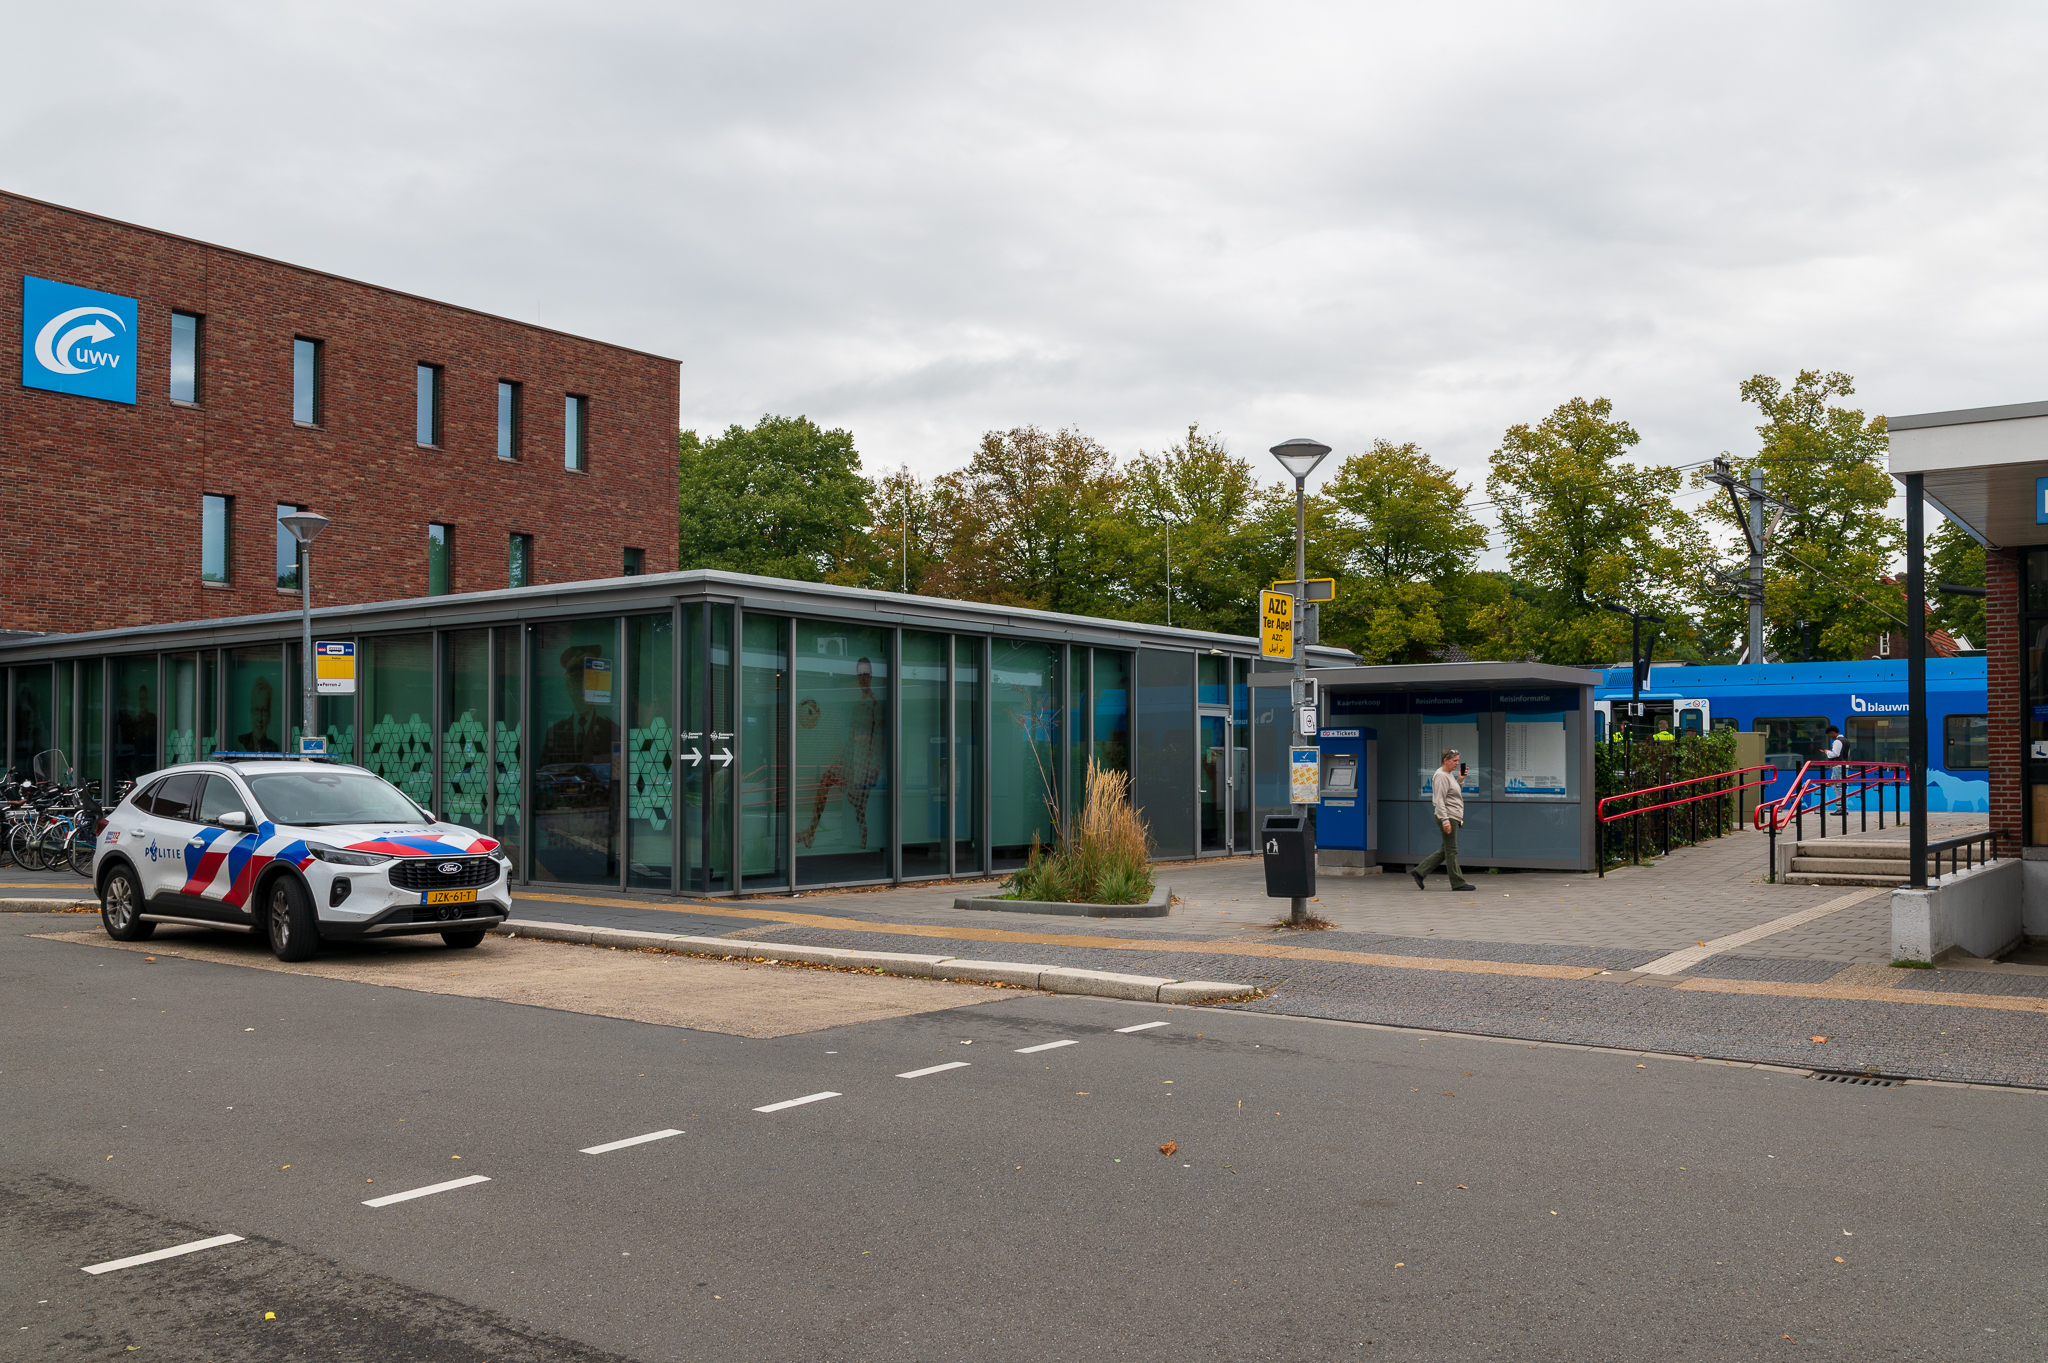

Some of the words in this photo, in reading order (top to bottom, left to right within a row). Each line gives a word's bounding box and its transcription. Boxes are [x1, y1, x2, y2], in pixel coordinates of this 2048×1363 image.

[76, 347, 120, 368] uwv
[1268, 598, 1287, 615] AZC
[1263, 616, 1275, 628] Ter
[1276, 618, 1292, 632] Apel
[1271, 633, 1283, 641] AZC
[1415, 697, 1463, 705] Reisinformatie
[1500, 694, 1551, 703] Reisinformatie
[1701, 700, 1707, 708] 2
[443, 864, 458, 872] Ford
[433, 891, 472, 903] JZK-61-T
